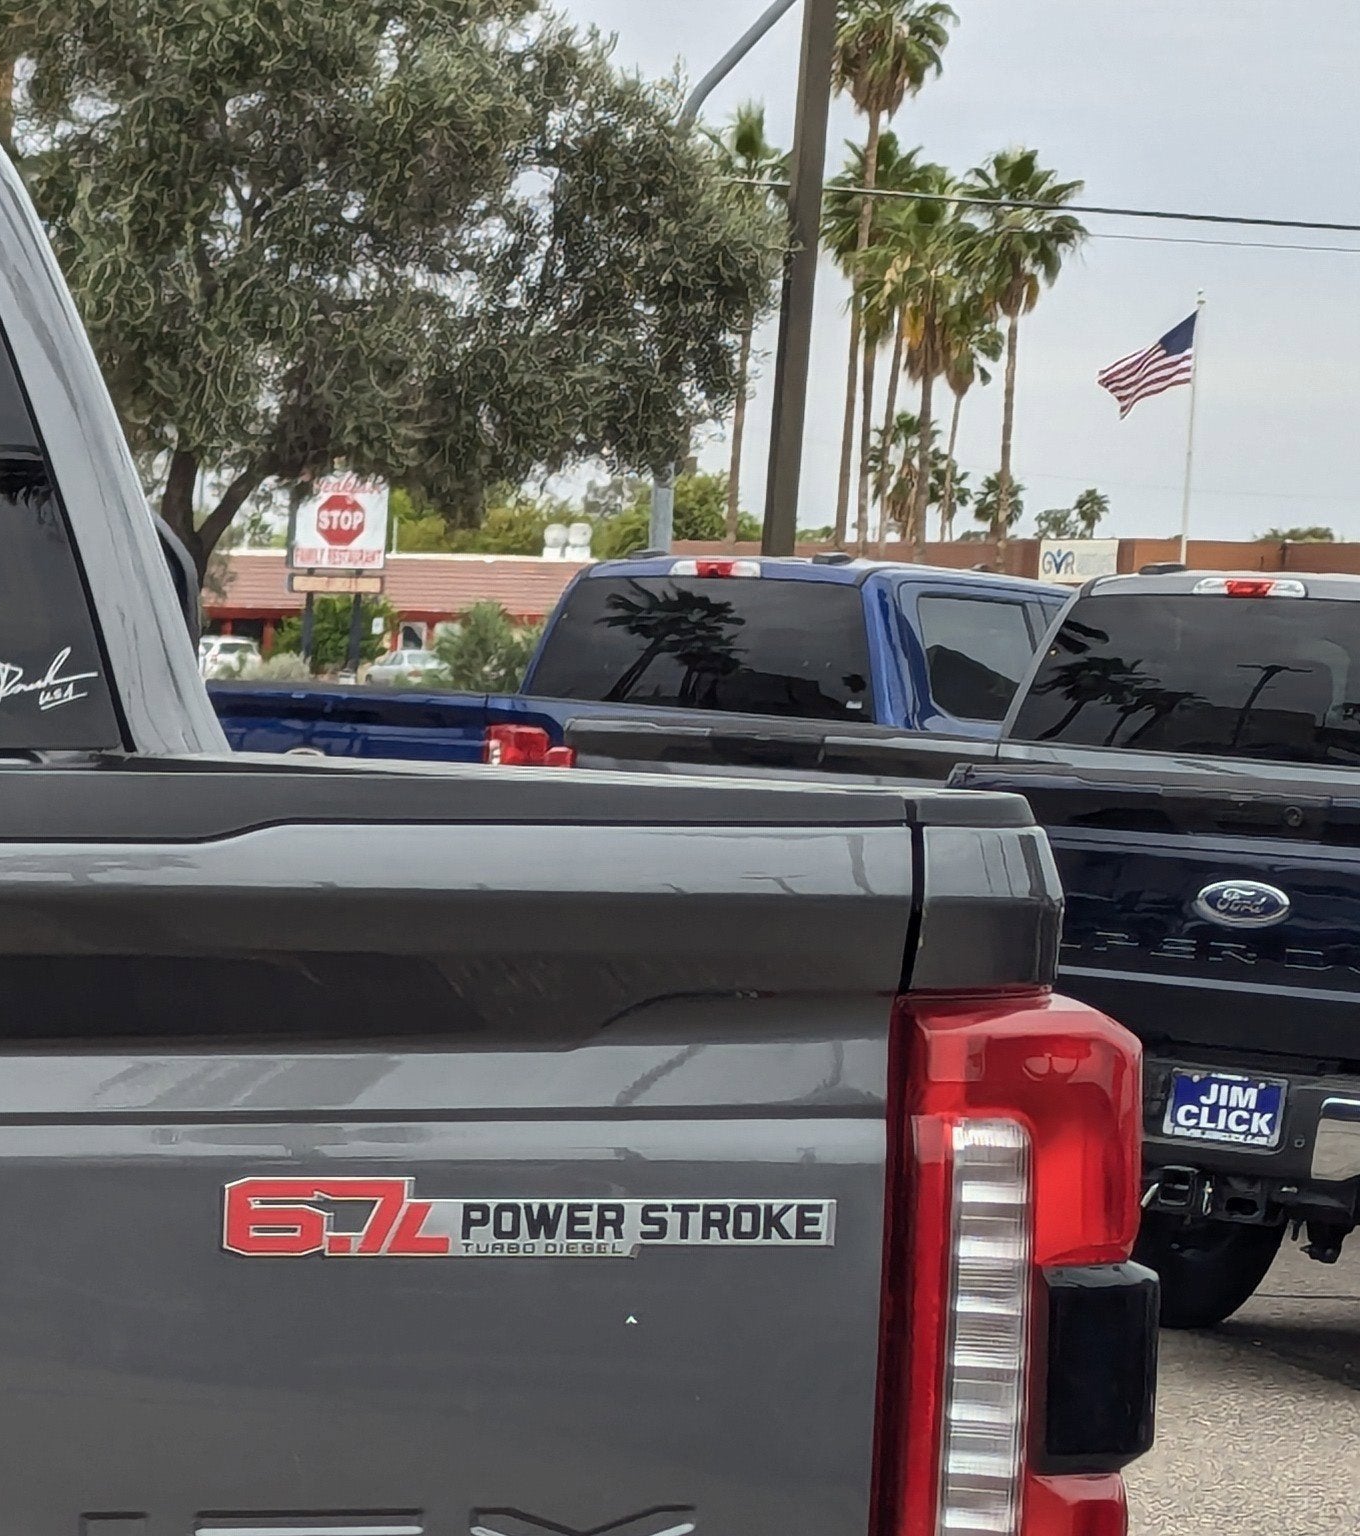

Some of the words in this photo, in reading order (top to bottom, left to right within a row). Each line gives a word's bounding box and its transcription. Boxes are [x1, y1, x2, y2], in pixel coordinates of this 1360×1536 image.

[318, 510, 363, 531] STOP
[1216, 888, 1268, 914] Ford
[1199, 1083, 1258, 1110] JIM
[1176, 1104, 1274, 1135] CLICK
[224, 1177, 451, 1257] 6.7L
[461, 1202, 625, 1241] POWER
[639, 1202, 824, 1241] STROKE
[462, 1243, 535, 1255] TURBO
[544, 1243, 624, 1255] DIESEL
